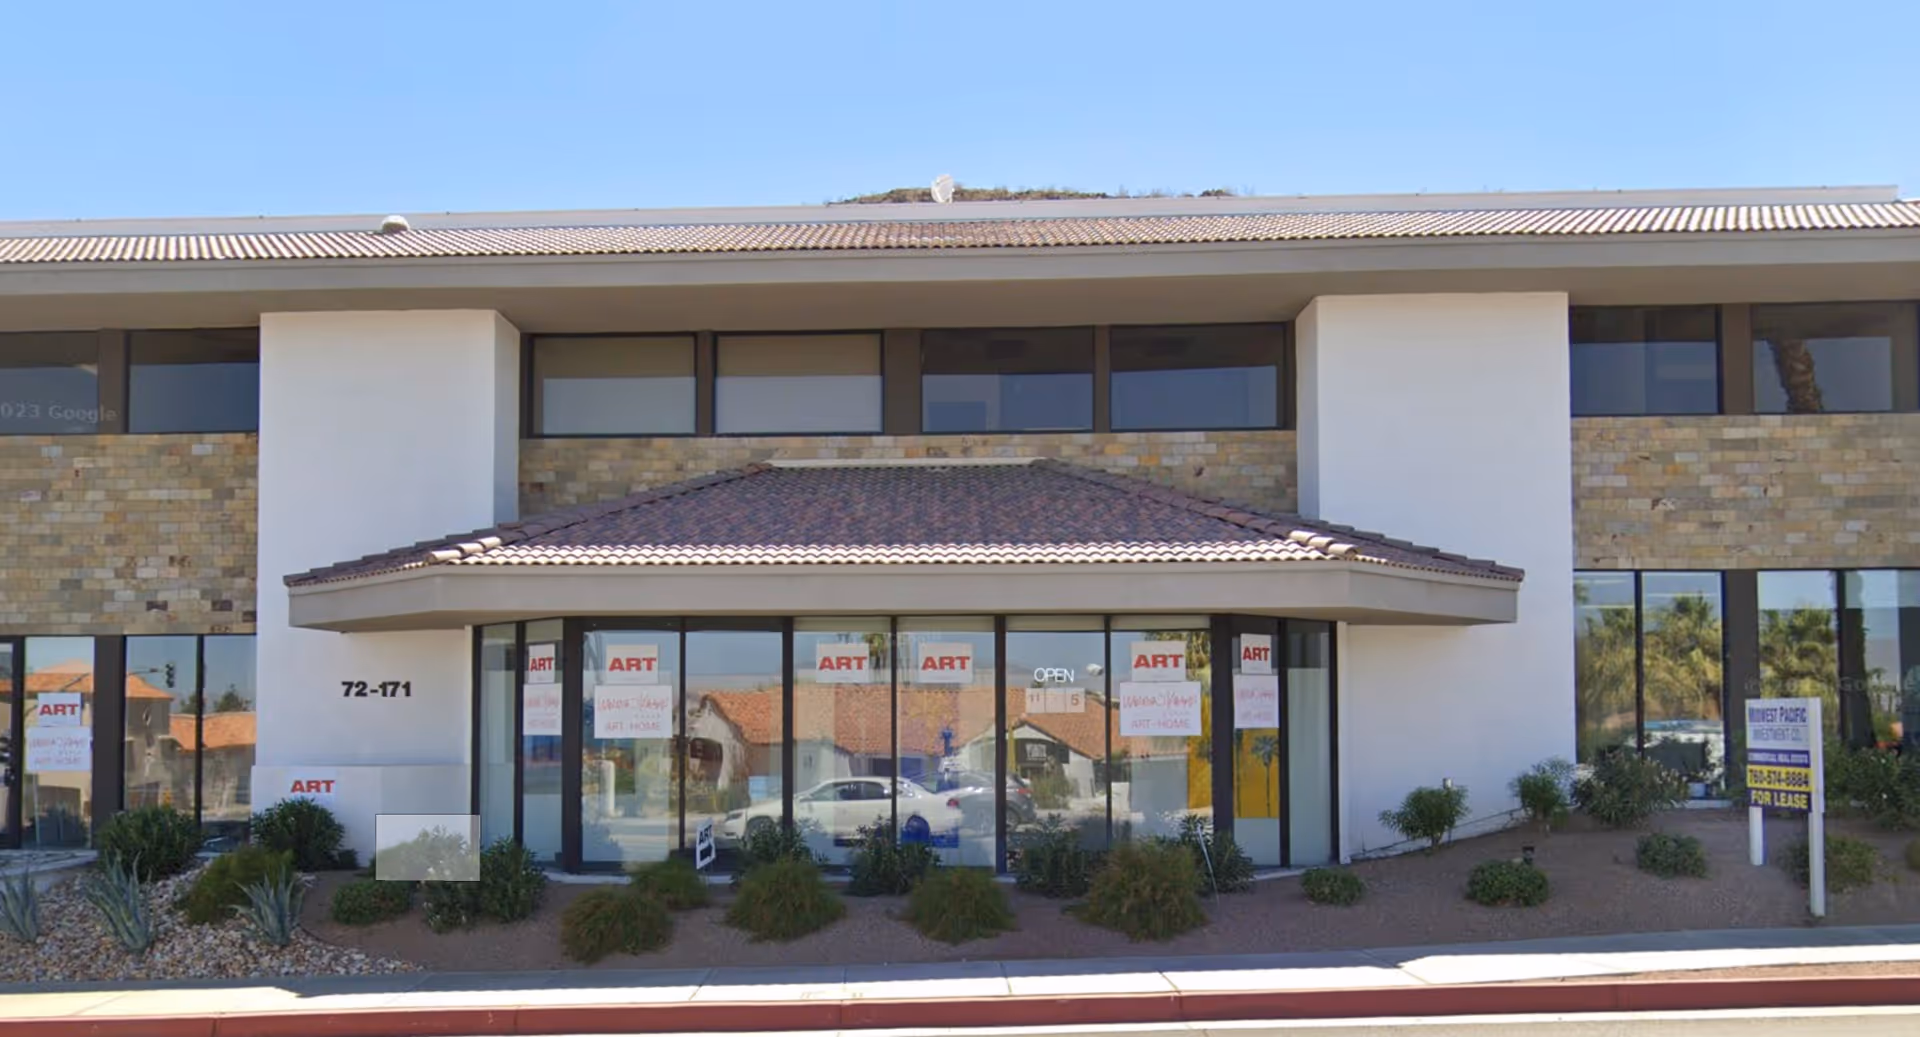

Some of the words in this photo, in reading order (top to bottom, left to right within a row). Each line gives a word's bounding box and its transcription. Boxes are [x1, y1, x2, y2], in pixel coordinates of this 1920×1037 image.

[1133, 654, 1184, 669] ART
[1242, 647, 1270, 661] ART
[529, 657, 554, 672] ART
[608, 657, 657, 672] ART
[818, 656, 868, 670] ART
[921, 656, 970, 670] ART
[1034, 667, 1075, 683] OPEN
[341, 680, 411, 697] 72-171
[39, 704, 80, 716] ART
[290, 780, 335, 793] ART
[1751, 790, 1772, 806] FOR
[1773, 791, 1809, 809] LEASE
